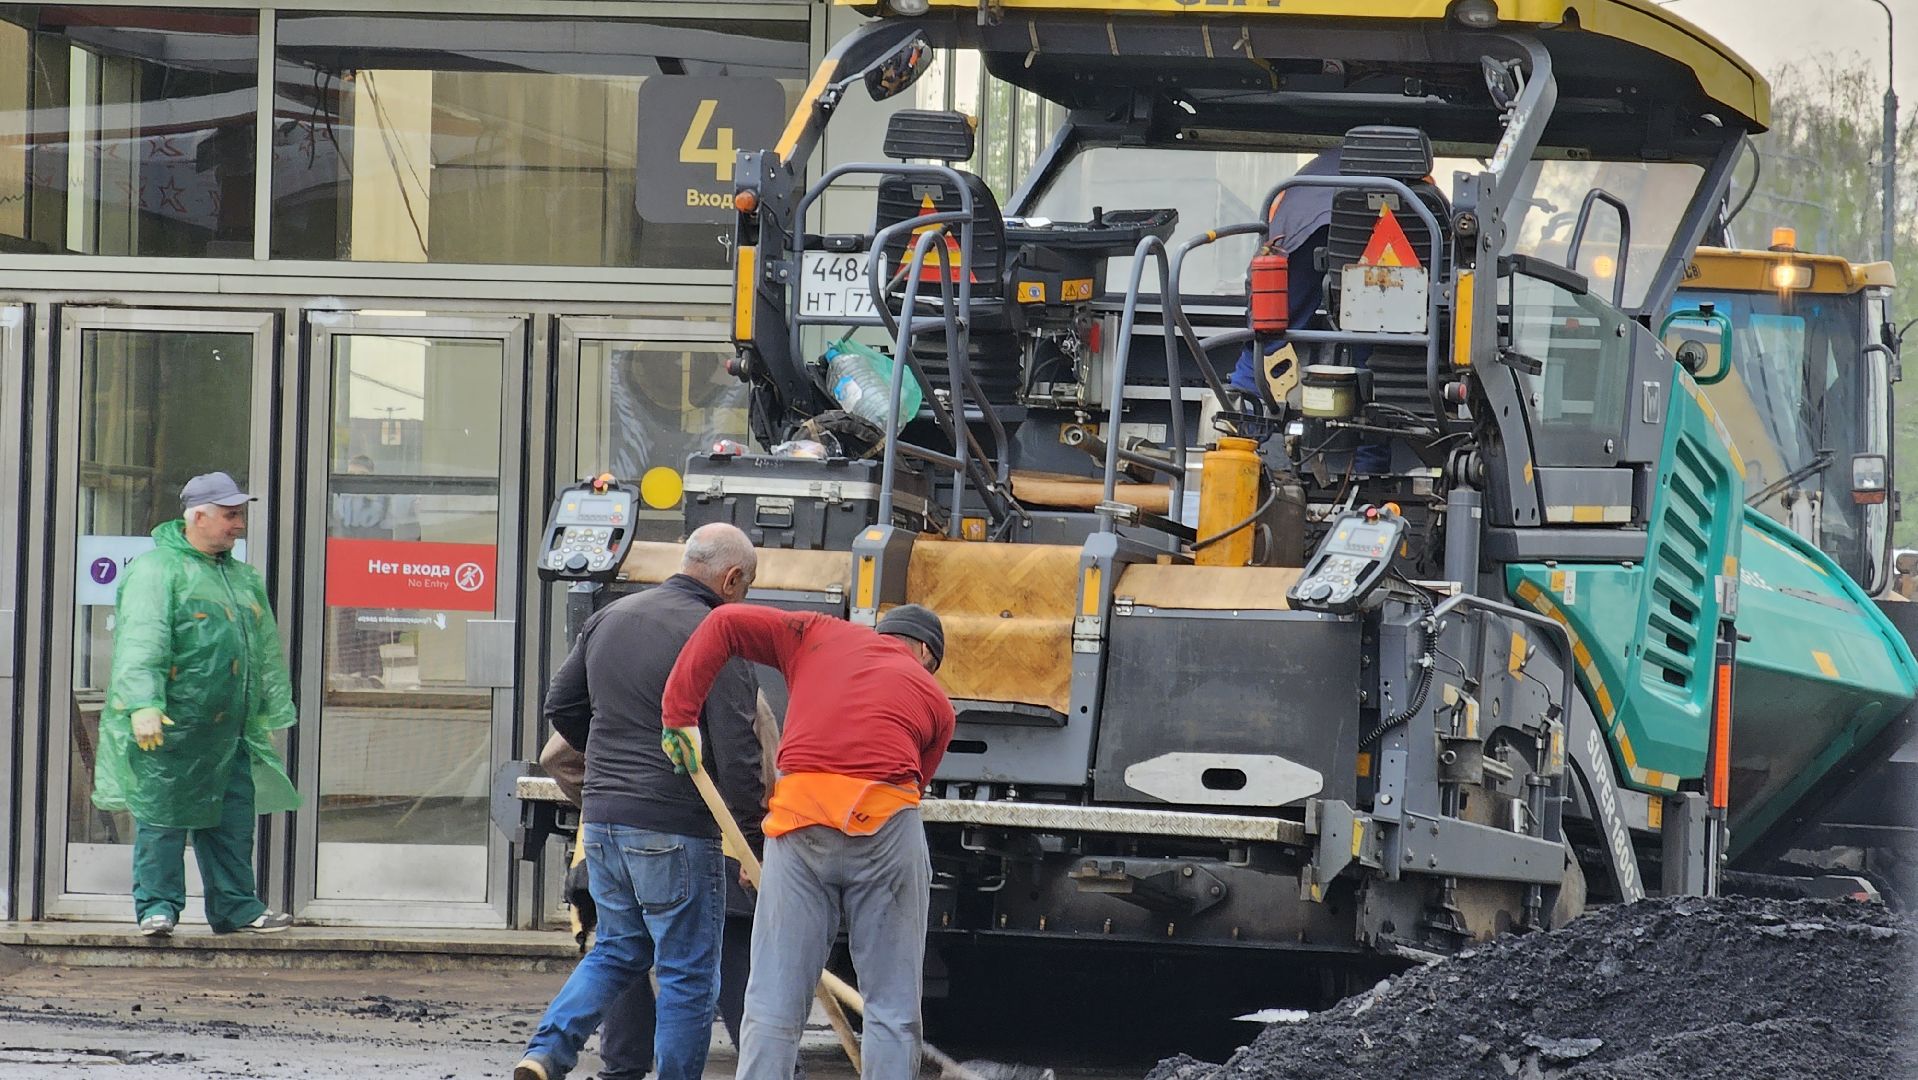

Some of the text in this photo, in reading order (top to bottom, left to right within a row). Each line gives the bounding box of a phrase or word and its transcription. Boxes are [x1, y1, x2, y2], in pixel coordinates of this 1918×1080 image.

[679, 99, 737, 181] 4
[686, 189, 735, 209] Вход
[1682, 265, 1699, 280] CB
[98, 562, 110, 579] 7
[368, 559, 450, 577] Нет входа
[408, 579, 449, 590] No Entry
[1586, 728, 1617, 825] SUPER
